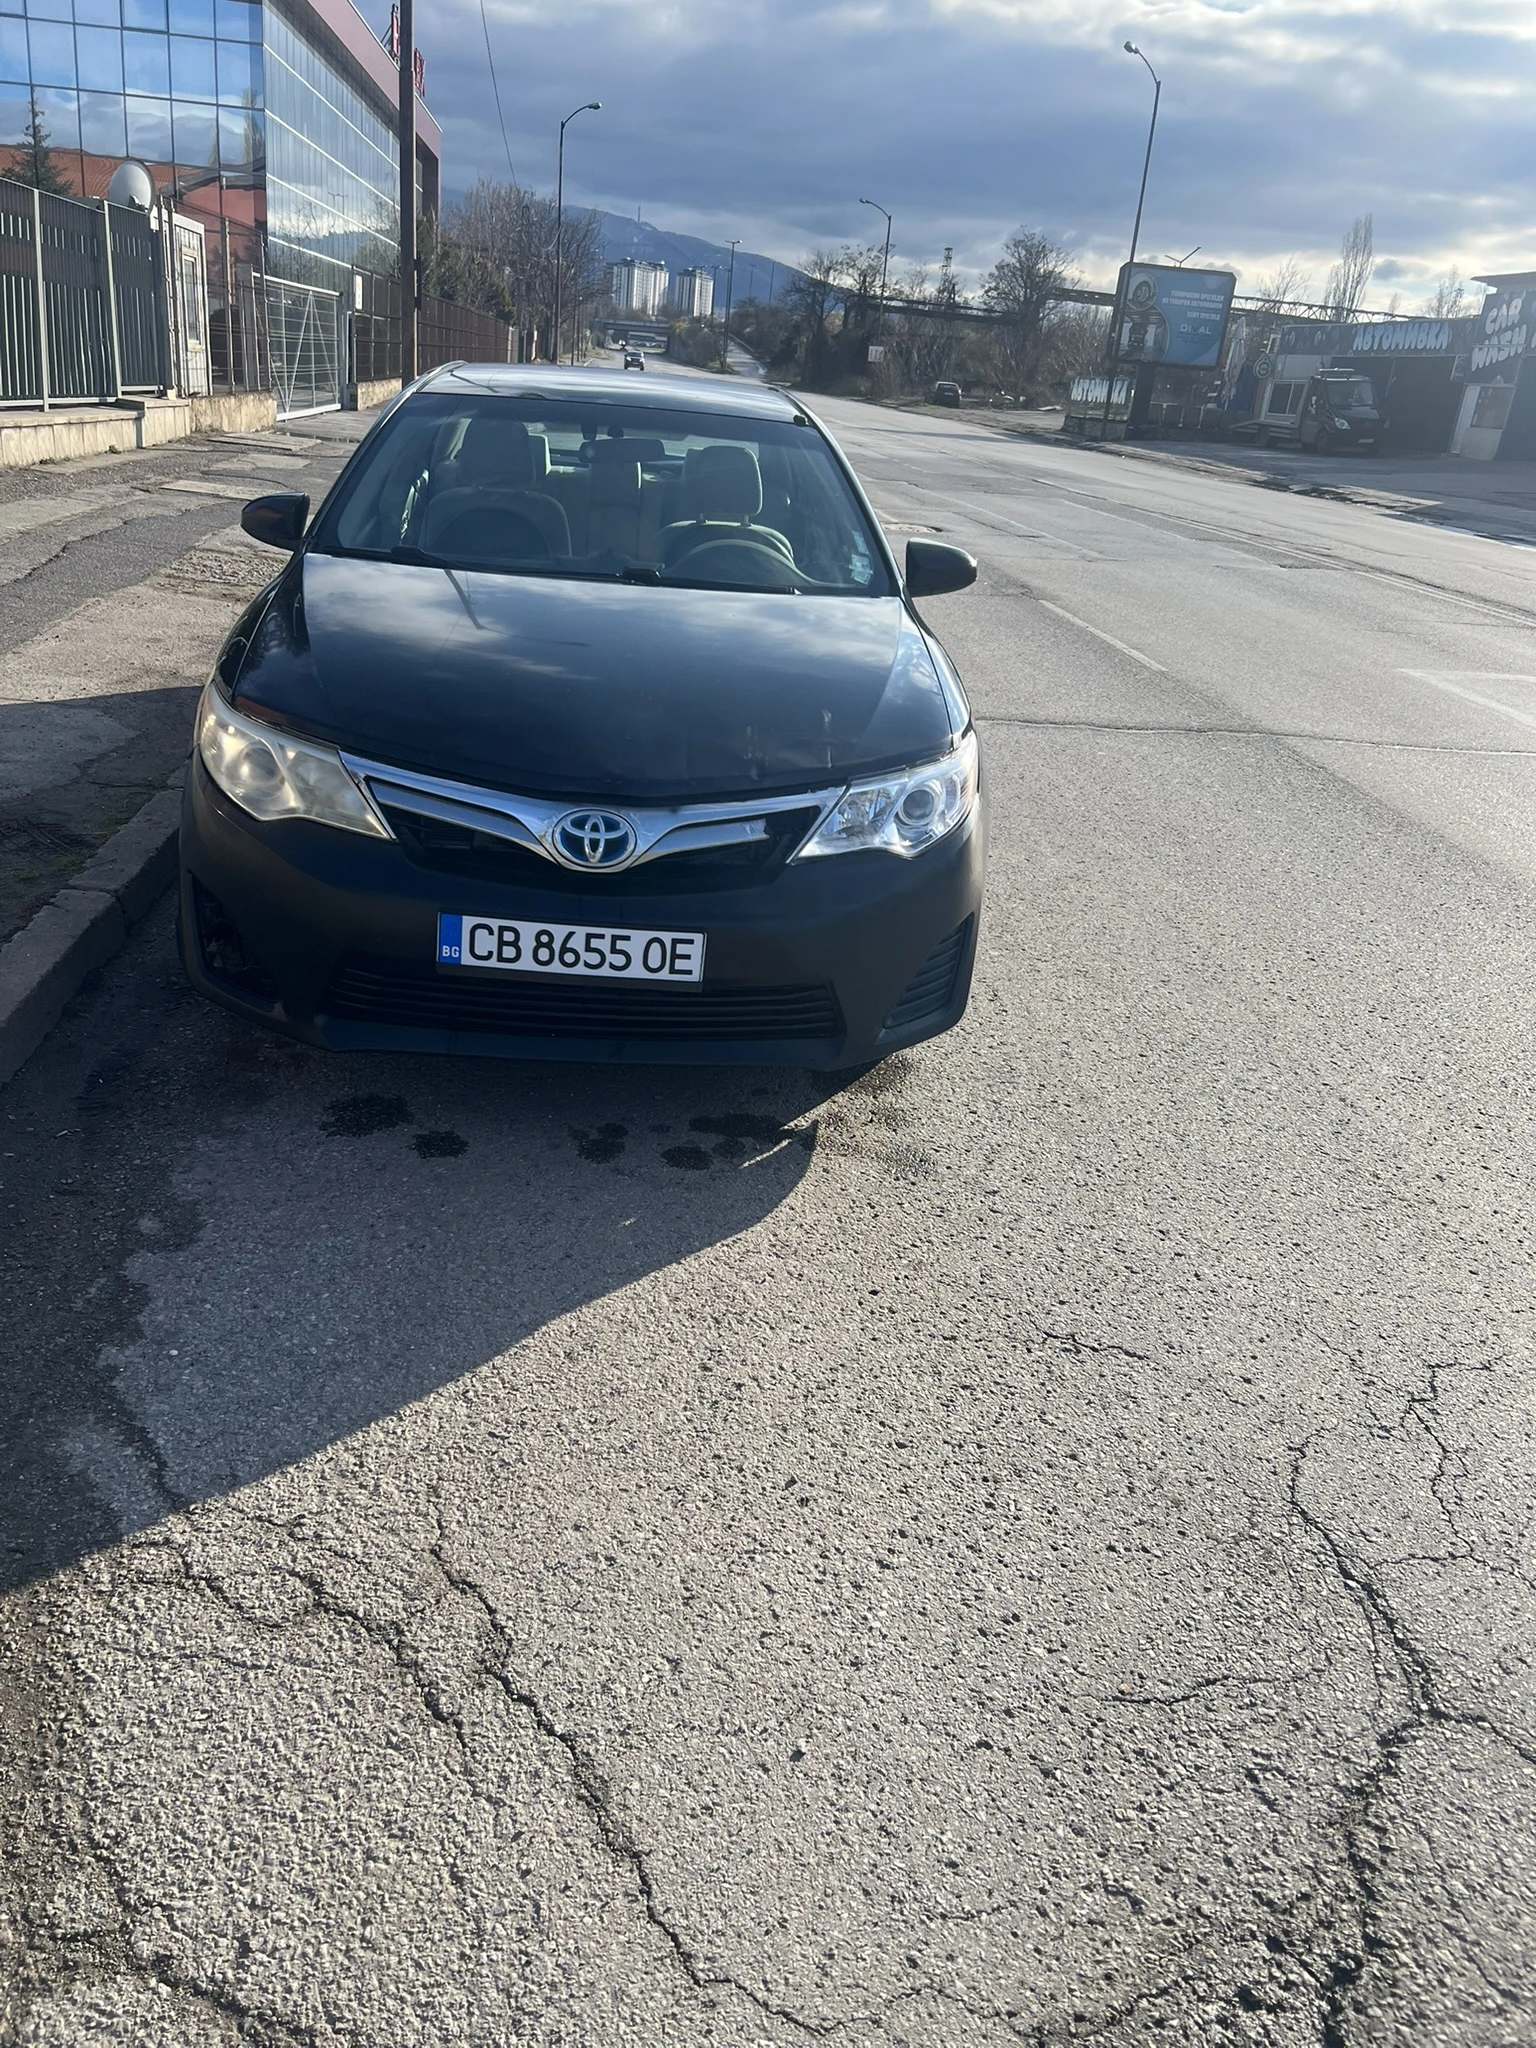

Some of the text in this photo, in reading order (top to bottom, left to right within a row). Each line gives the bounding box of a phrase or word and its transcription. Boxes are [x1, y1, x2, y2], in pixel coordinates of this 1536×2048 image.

[1180, 324, 1212, 334] DIVAL
[1485, 298, 1522, 334] CAR
[1352, 322, 1449, 351] АВТОМИВКА
[1472, 324, 1527, 371] WASH
[1070, 376, 1128, 405] АВТОМИКА
[441, 945, 460, 958] BG
[468, 923, 695, 976] CB 8655 OE
